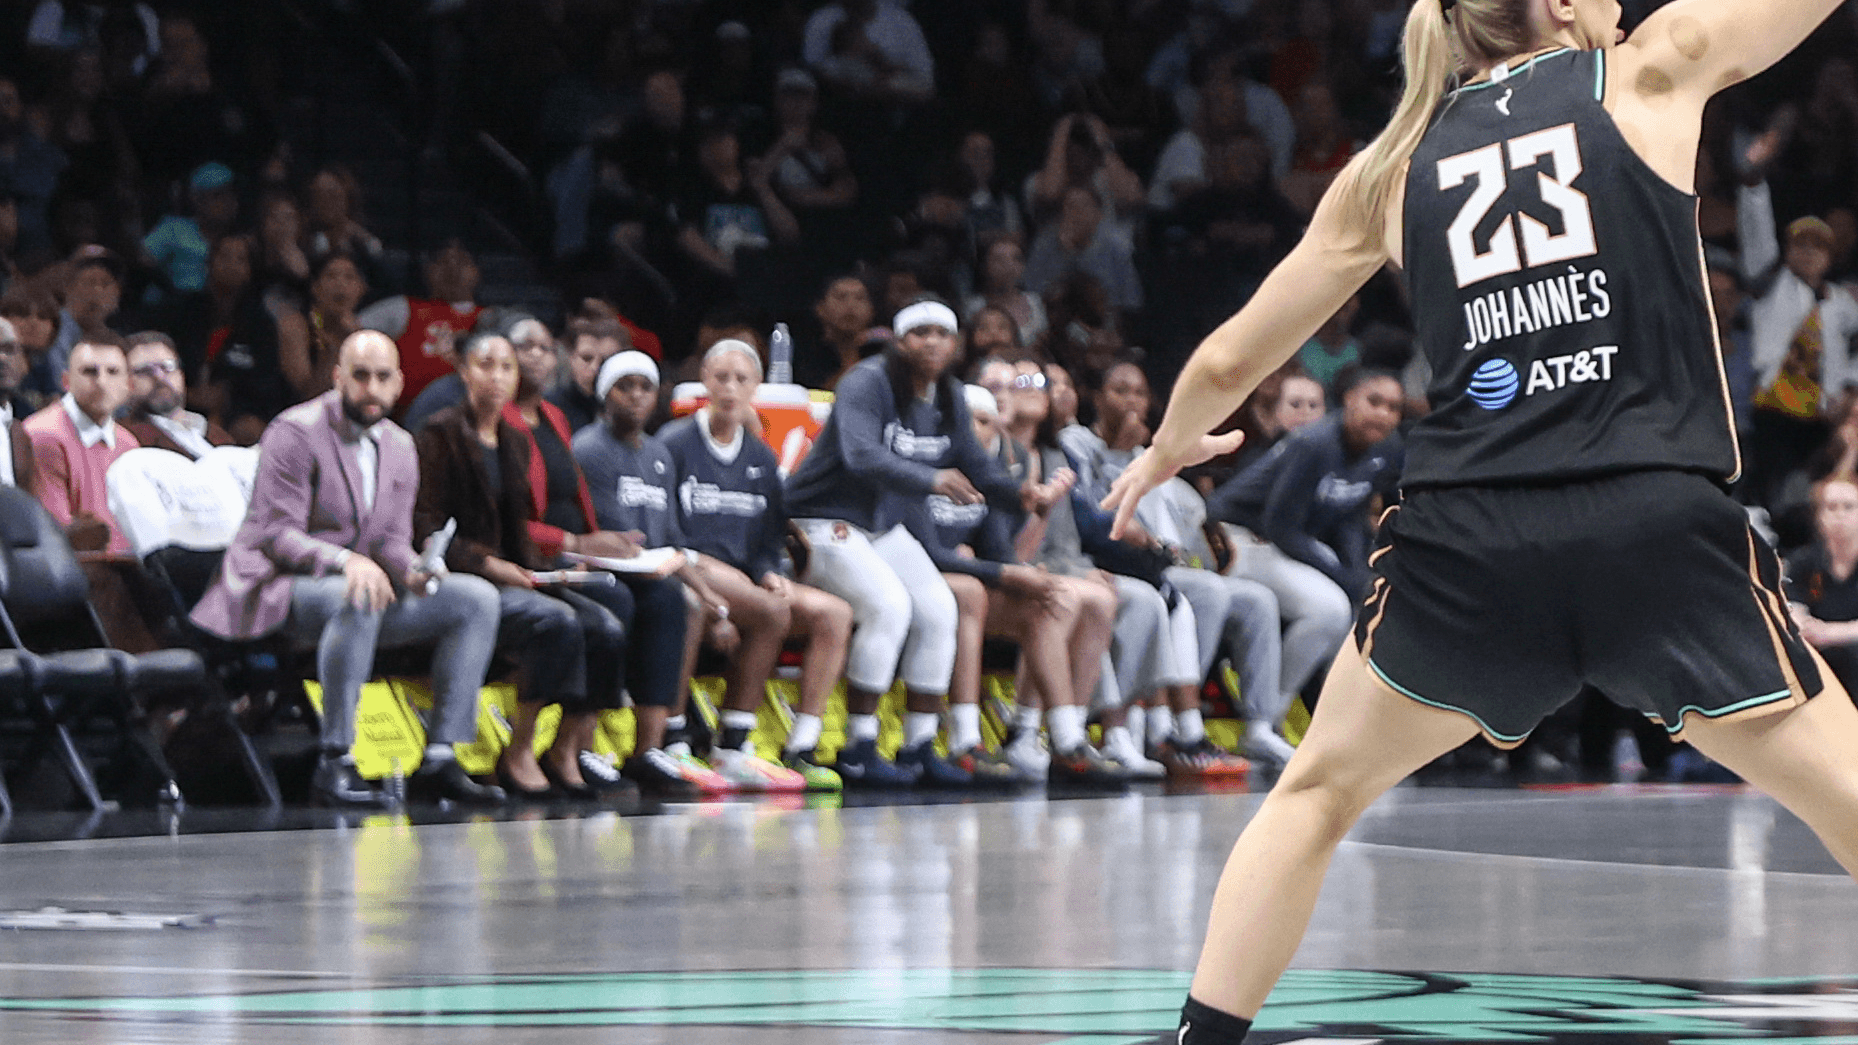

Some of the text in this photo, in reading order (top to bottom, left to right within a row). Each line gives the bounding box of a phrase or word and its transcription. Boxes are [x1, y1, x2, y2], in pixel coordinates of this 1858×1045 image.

[1436, 122, 1598, 289] 23
[1463, 265, 1611, 351] JOHANNÈS
[1526, 345, 1619, 395] AT&T
